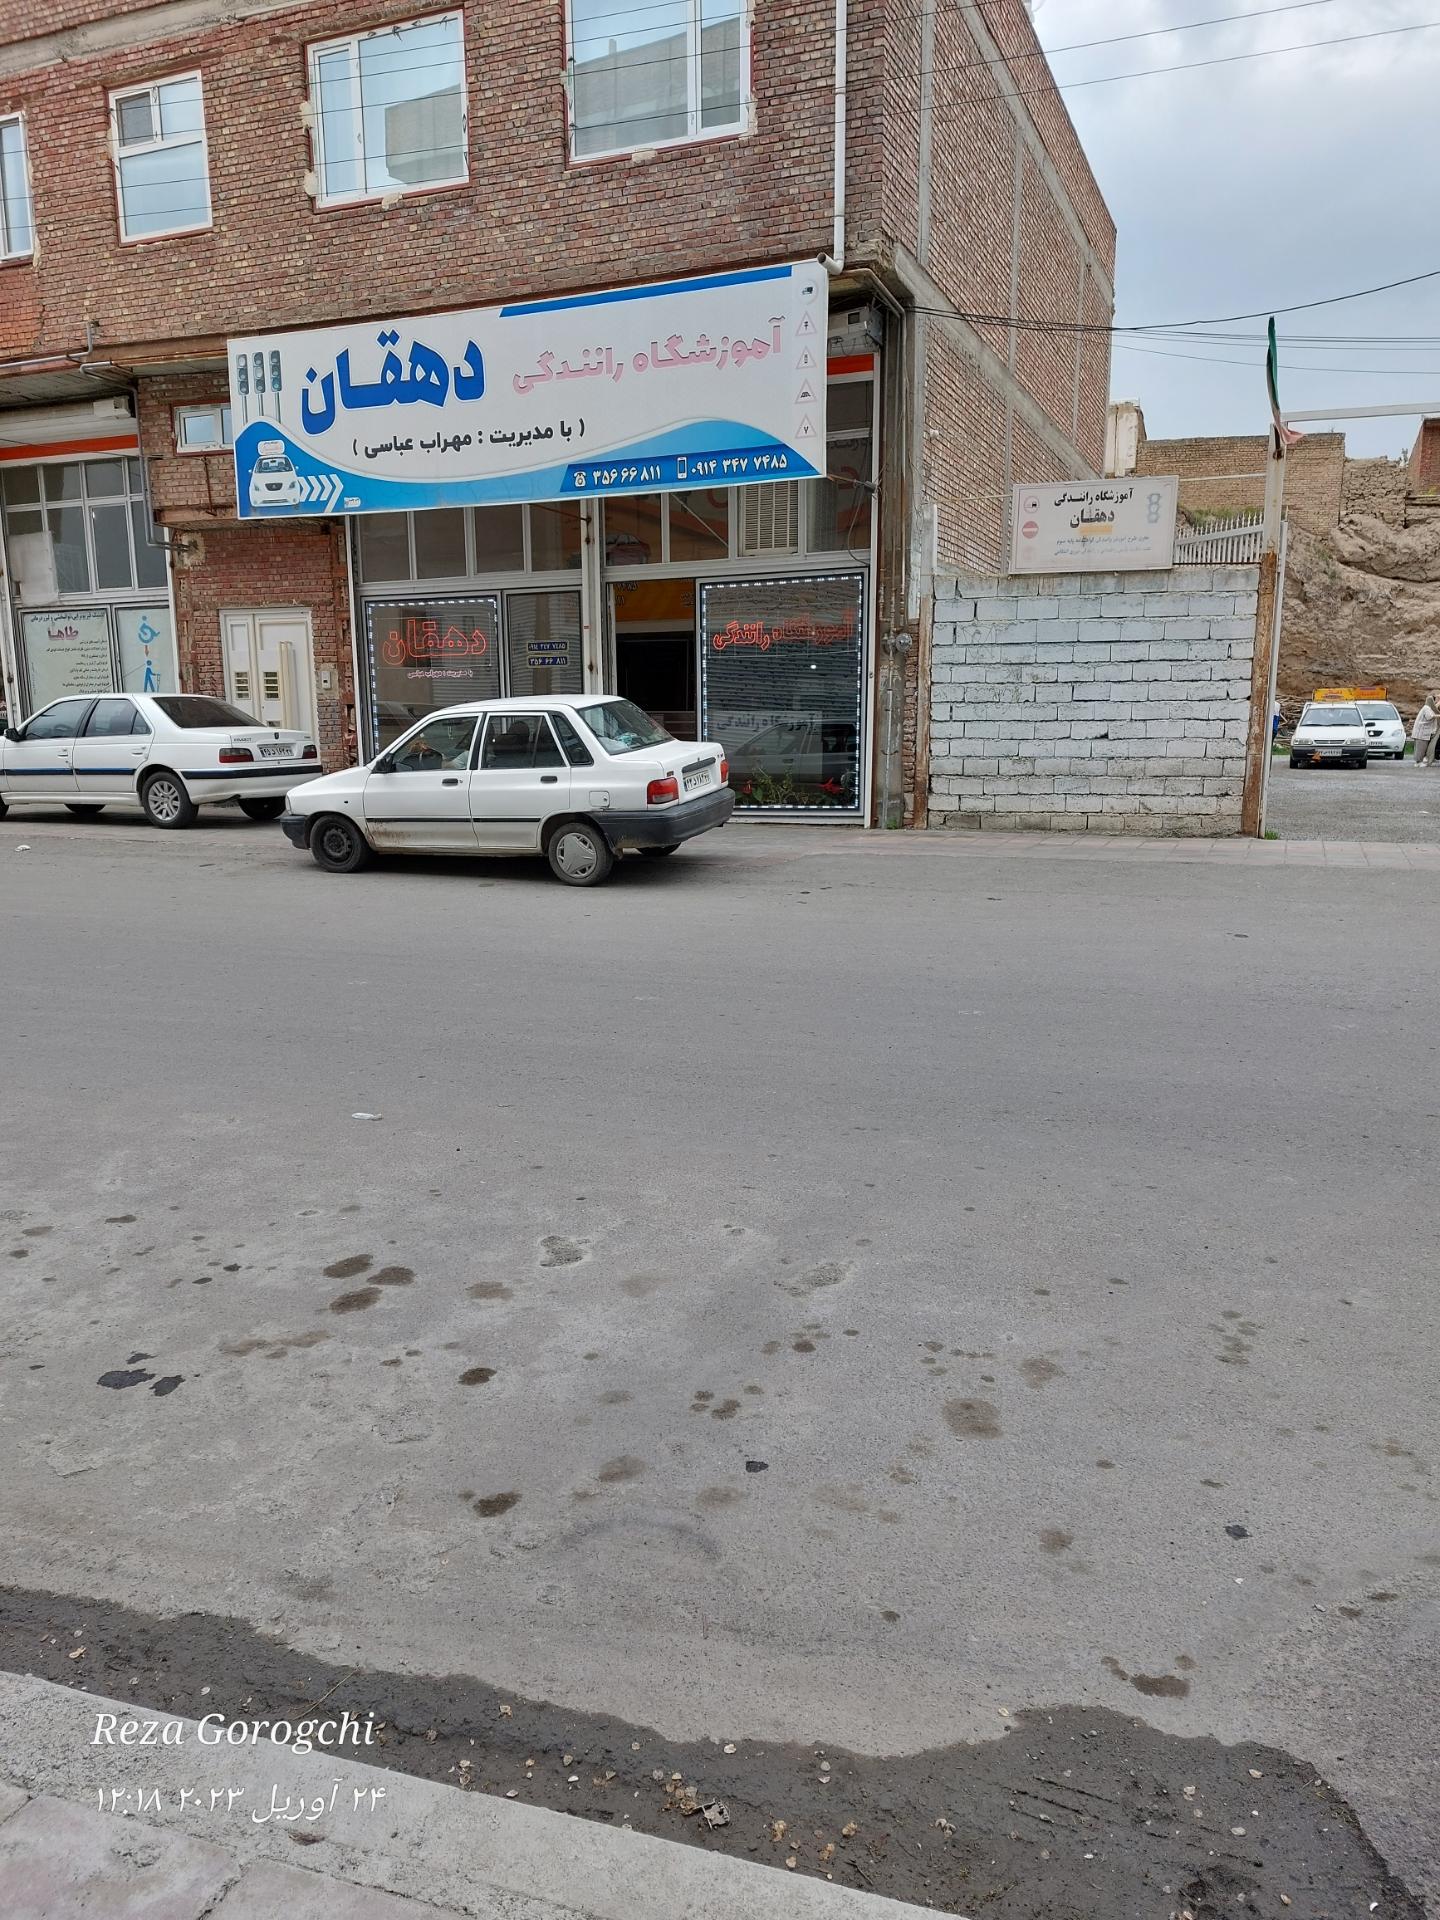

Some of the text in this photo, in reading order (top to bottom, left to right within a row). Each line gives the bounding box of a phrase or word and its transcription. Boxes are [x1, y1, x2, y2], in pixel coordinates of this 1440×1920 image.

[512, 315, 786, 395] آموزشگاه رانندگی
[301, 329, 485, 436] دهقان
[489, 425, 553, 447] مدیریت
[560, 420, 572, 442] با
[364, 435, 414, 459] عباسی
[419, 432, 472, 453] مهراب
[1054, 488, 1134, 506] آموزشگاه رانندگی
[1070, 508, 1115, 528] دهقان
[48, 625, 79, 639] طاها
[382, 619, 487, 665] دهقان
[713, 620, 770, 650] رانندگی
